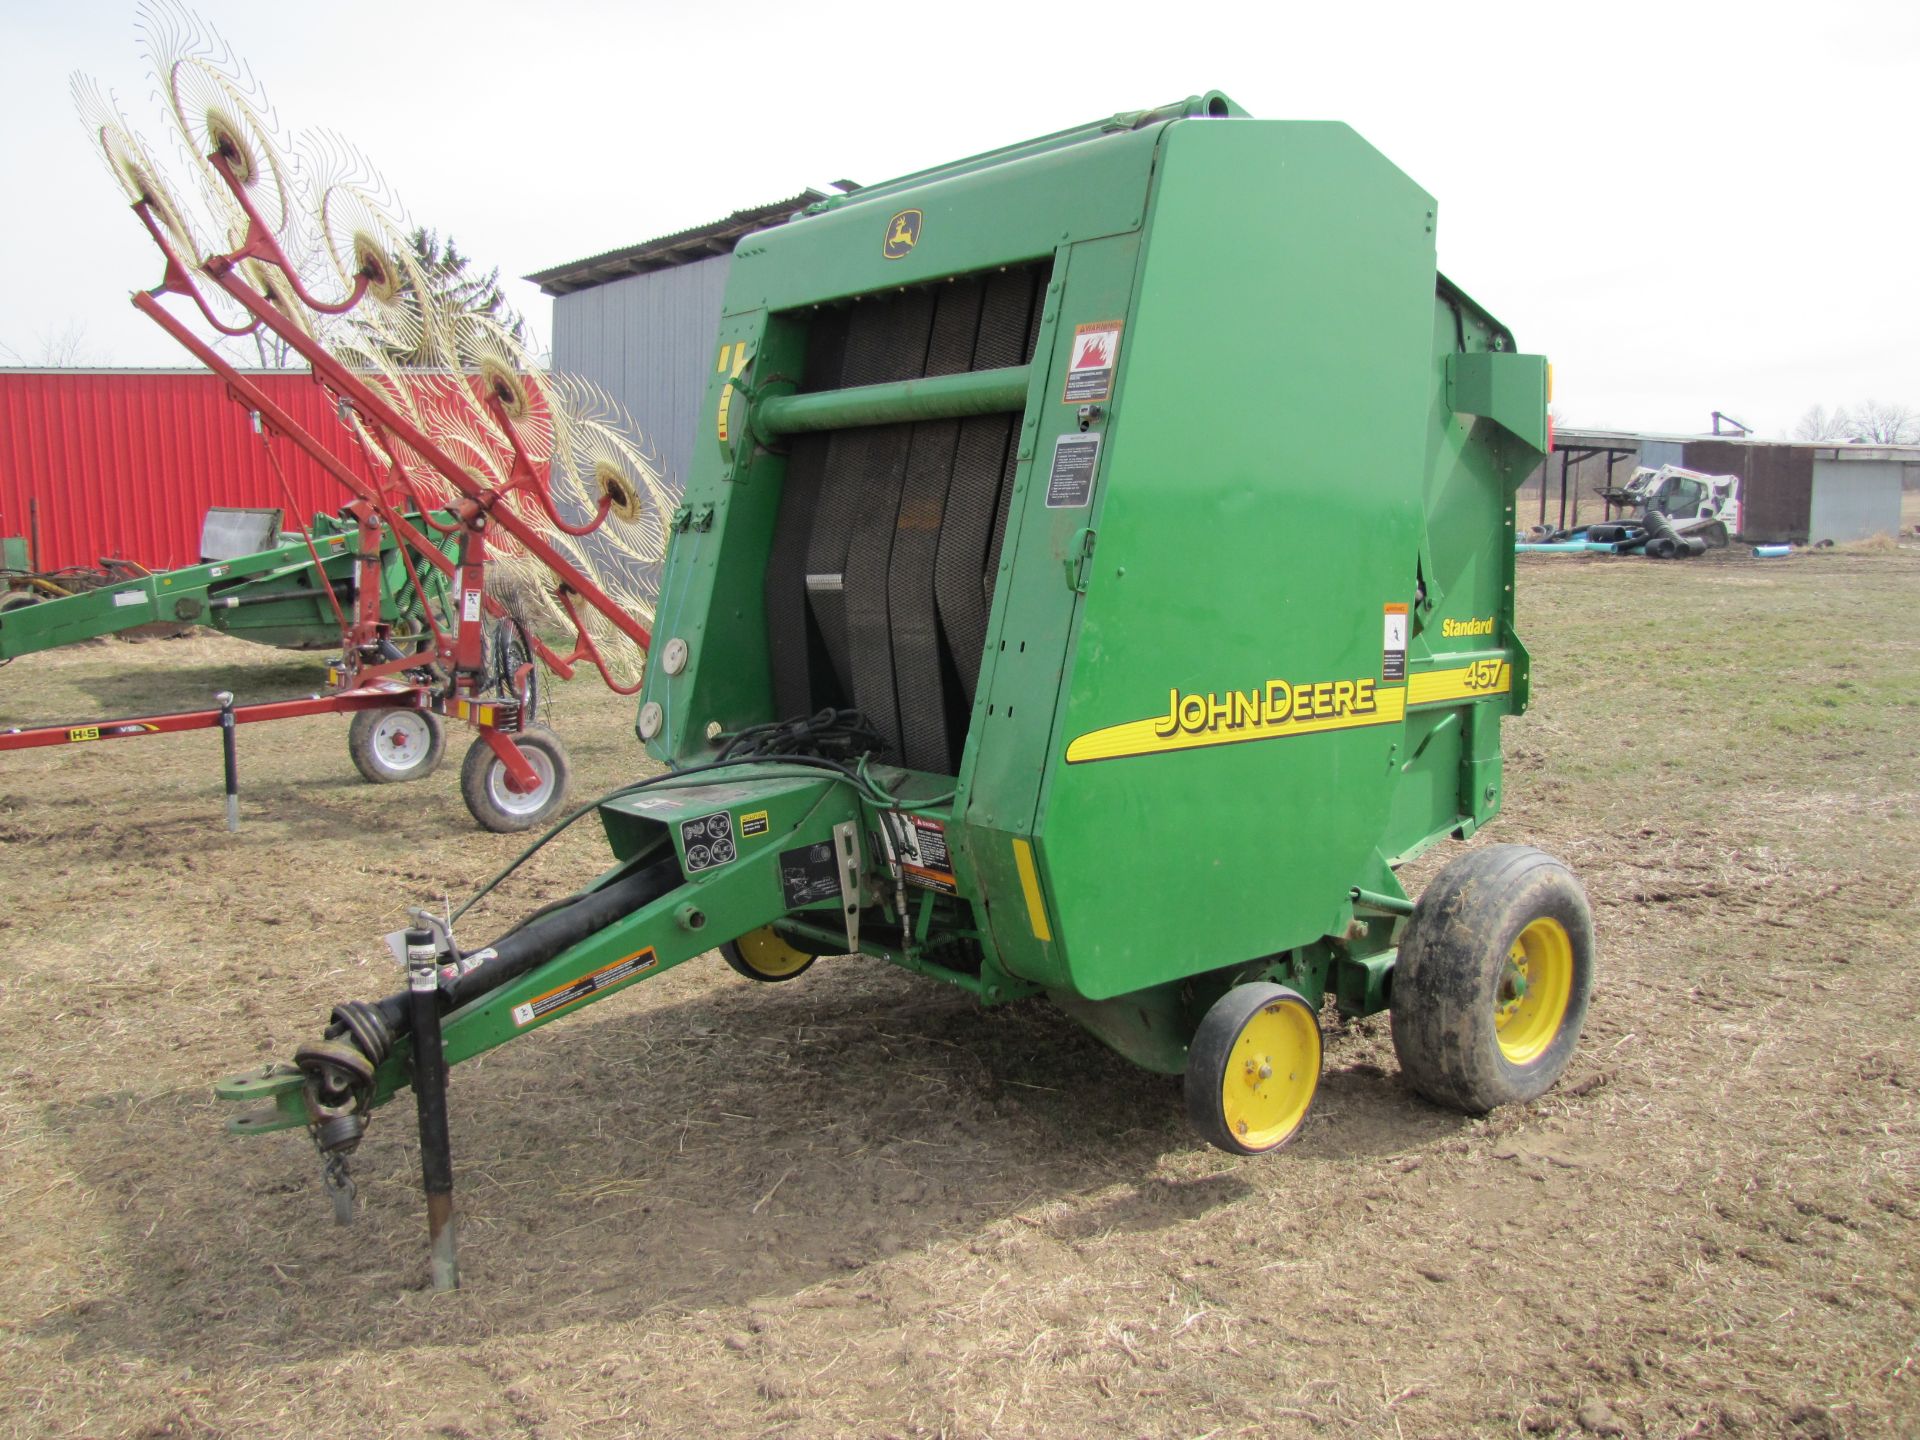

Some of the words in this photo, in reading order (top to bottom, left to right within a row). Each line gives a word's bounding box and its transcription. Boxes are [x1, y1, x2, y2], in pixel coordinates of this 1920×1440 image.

[1442, 616, 1494, 637] Standard
[1464, 659, 1504, 689] 457
[1155, 688, 1260, 737] JOHN
[1265, 679, 1376, 722] DEERE
[72, 728, 98, 739] H&S
